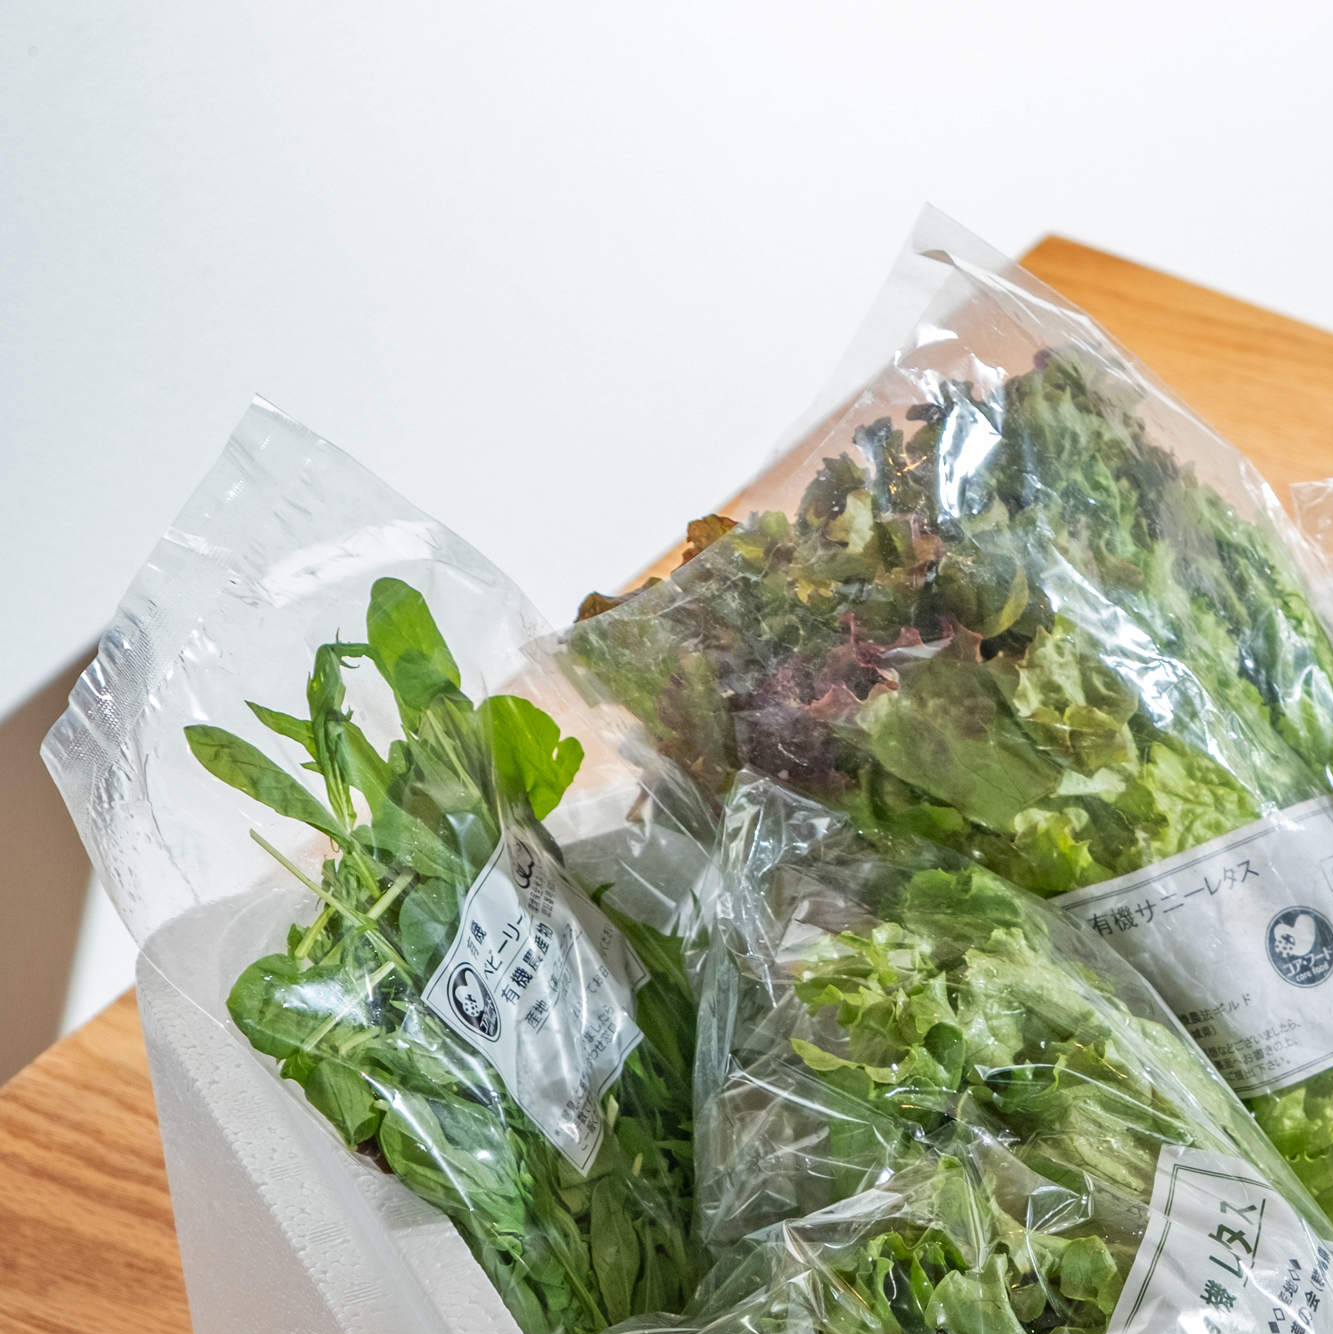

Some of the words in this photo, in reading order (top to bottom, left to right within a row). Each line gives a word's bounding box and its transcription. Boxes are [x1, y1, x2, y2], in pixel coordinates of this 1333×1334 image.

[1088, 860, 1260, 938] 有機サニーレタス
[500, 921, 554, 1007] 有機農産物
[1283, 946, 1333, 977] コア・フード
